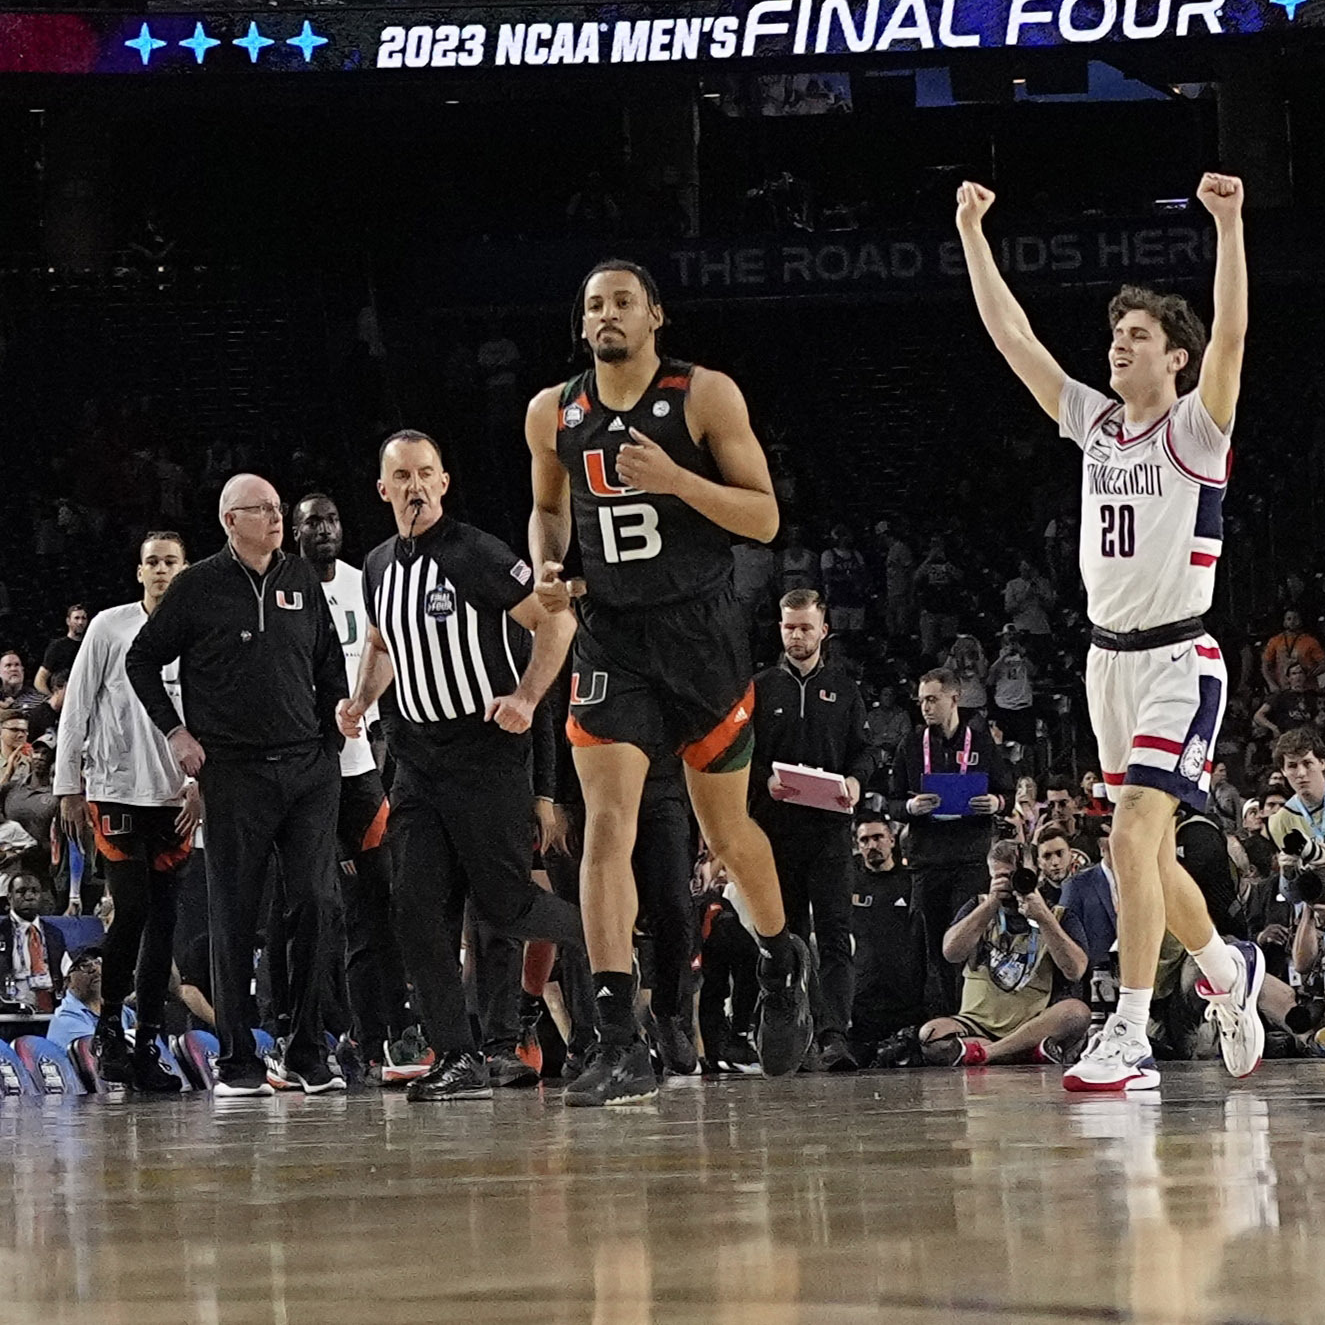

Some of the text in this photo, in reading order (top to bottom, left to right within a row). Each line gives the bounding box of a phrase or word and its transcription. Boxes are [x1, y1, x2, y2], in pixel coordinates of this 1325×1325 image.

[376, 24, 487, 68] 2023
[610, 16, 739, 63] MEN'S
[671, 247, 766, 287] THE
[782, 240, 923, 283] ROAD
[939, 233, 1083, 276] EDS
[597, 503, 663, 564] 13
[1100, 504, 1135, 558] 20
